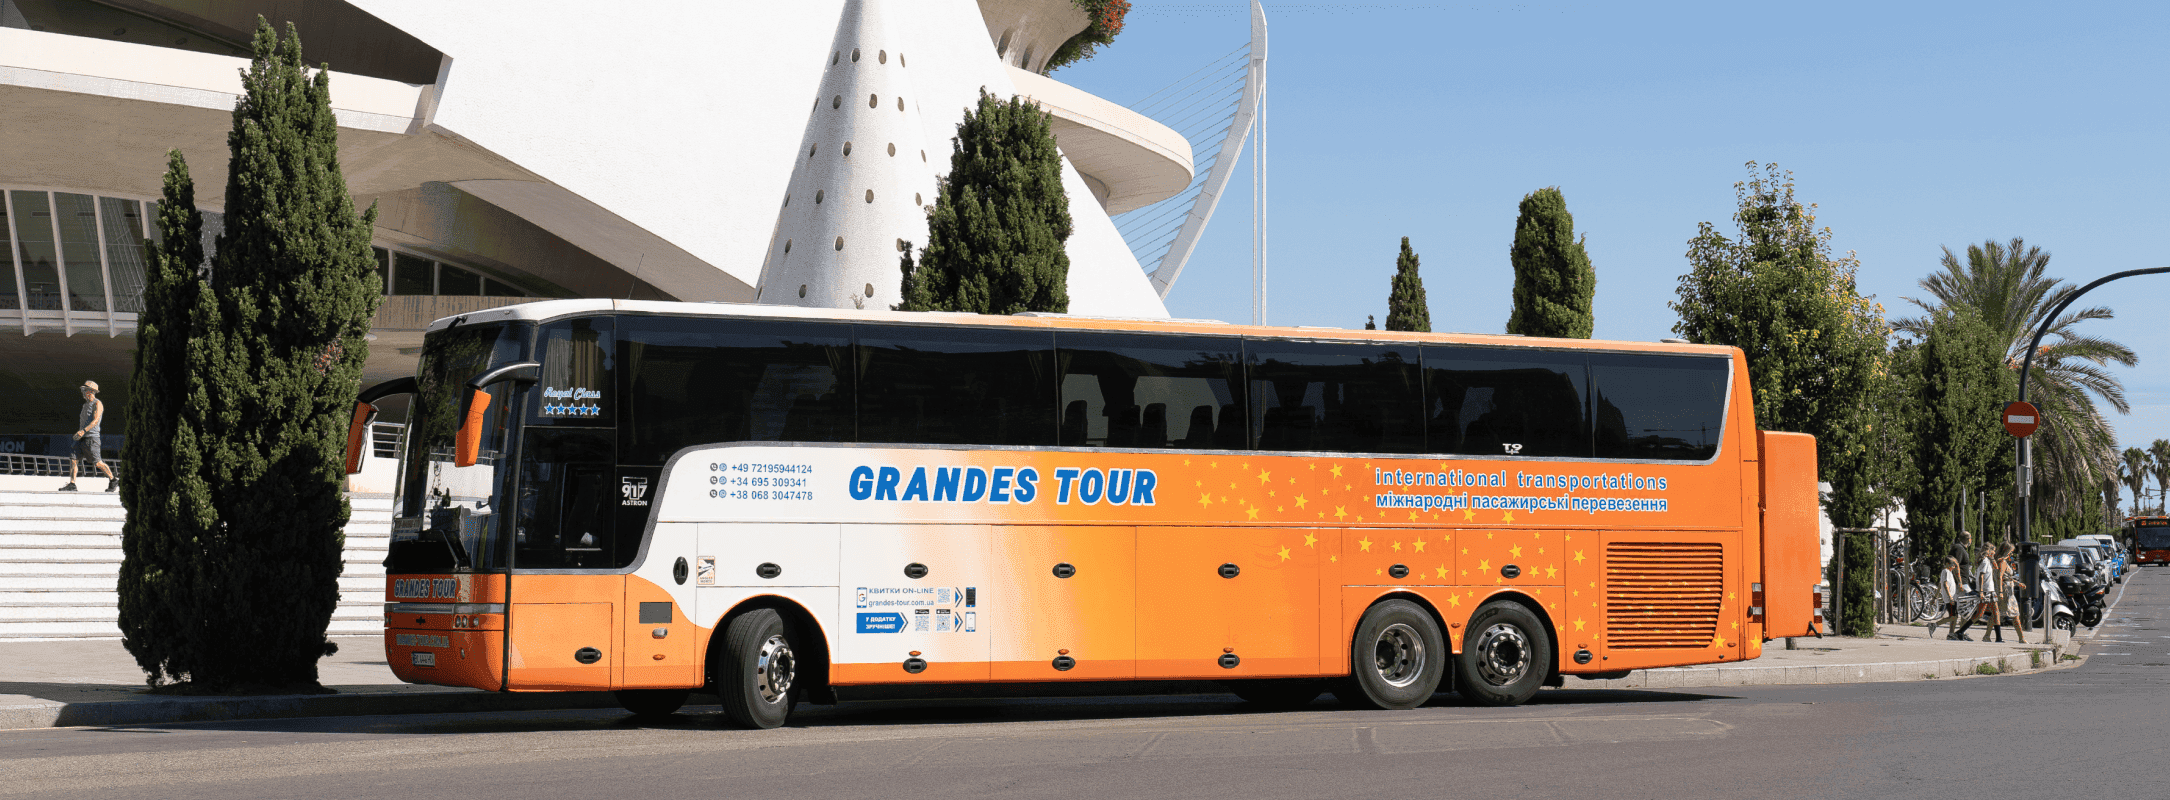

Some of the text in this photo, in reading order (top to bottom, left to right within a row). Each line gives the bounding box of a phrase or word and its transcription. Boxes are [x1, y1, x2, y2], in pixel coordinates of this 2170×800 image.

[574, 388, 600, 400] Class
[732, 464, 812, 474] +49 72195944124
[730, 477, 806, 487] +34 695 309341
[848, 465, 1157, 506] GRANDES TOUR
[1375, 468, 1668, 491] international transportations
[730, 490, 813, 500] +38 068 3047478
[1375, 492, 1668, 515] міжнародні пасажирські перевезення
[394, 578, 457, 598] GRANDES TOUR
